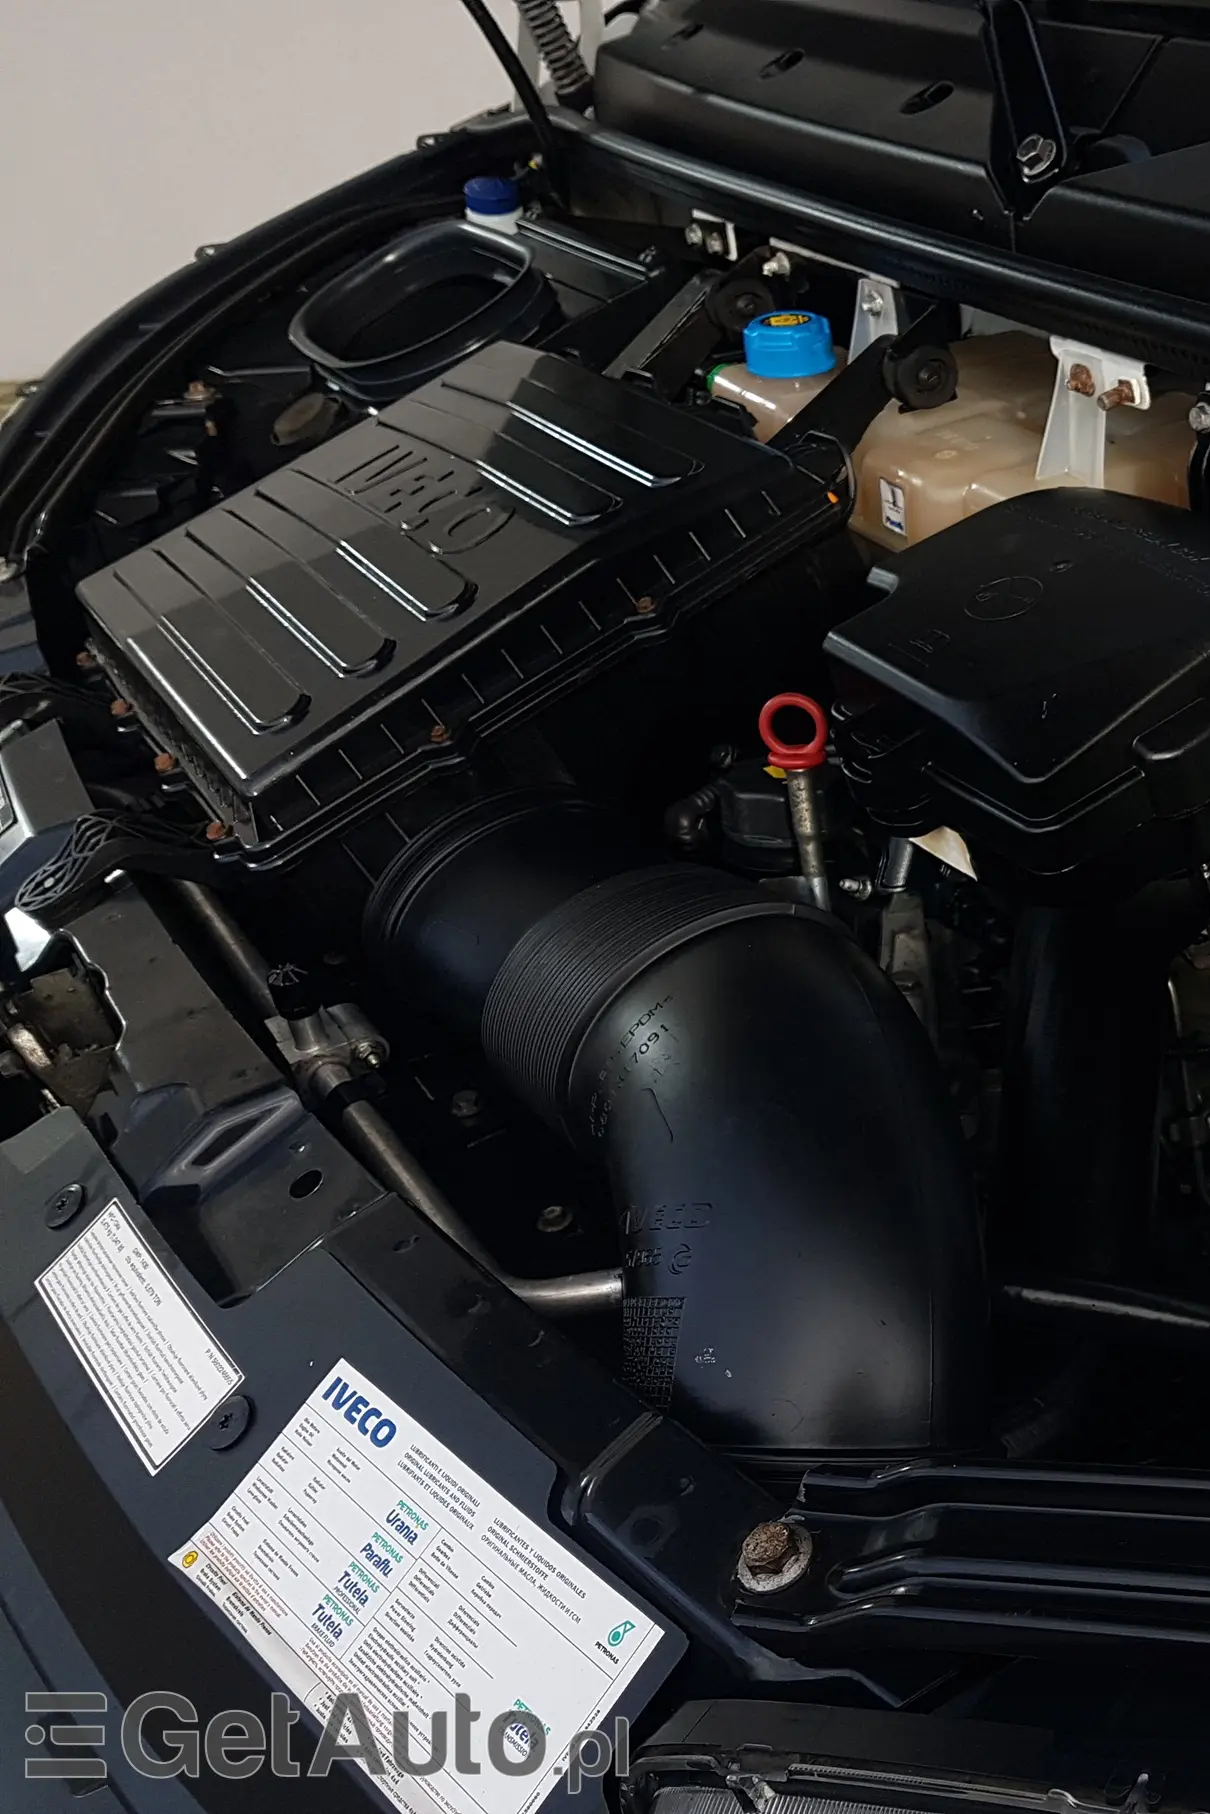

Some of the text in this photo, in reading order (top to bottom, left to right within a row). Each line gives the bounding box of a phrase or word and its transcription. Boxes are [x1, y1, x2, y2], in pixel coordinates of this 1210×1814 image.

[321, 1376, 397, 1450] IVECO
[404, 1452, 475, 1517] ORIGINAL LUBRICANTS AND FLUIDS
[410, 1444, 438, 1470] LUBRIFICANTI
[440, 1471, 458, 1488] LIQUIDI
[456, 1485, 480, 1507] ORIGINALI
[397, 1460, 424, 1485] LUBRIFIANTS
[429, 1488, 450, 1508] LIQUIDES
[449, 1506, 474, 1529] ORIGINAUX
[386, 1509, 417, 1544] Urania
[396, 1500, 428, 1530] PETRONAS
[360, 1542, 392, 1577] Paraflu
[372, 1532, 403, 1563] PETRONAS
[487, 1526, 548, 1580] ORIGINAL SCHMIERSTOFFE
[493, 1517, 529, 1549] LUBRIFICANTES
[532, 1551, 556, 1573] LIQUIDOS
[555, 1571, 586, 1598] ORIGINALES
[338, 1570, 368, 1606] Tutela
[348, 1561, 379, 1592] PETRONAS
[481, 1534, 519, 1569] ОРИГИНАЛЬНЫЕ
[518, 1567, 536, 1586] МАСЛА,
[536, 1583, 566, 1610] ЖИДКОСТИ
[322, 1594, 353, 1626] PETRONAS
[333, 1586, 360, 1614] PROFESSIONAL
[311, 1622, 335, 1647] BRAKE FLUID
[312, 1603, 342, 1640] Tutela
[594, 1641, 619, 1664] PETRONAS
